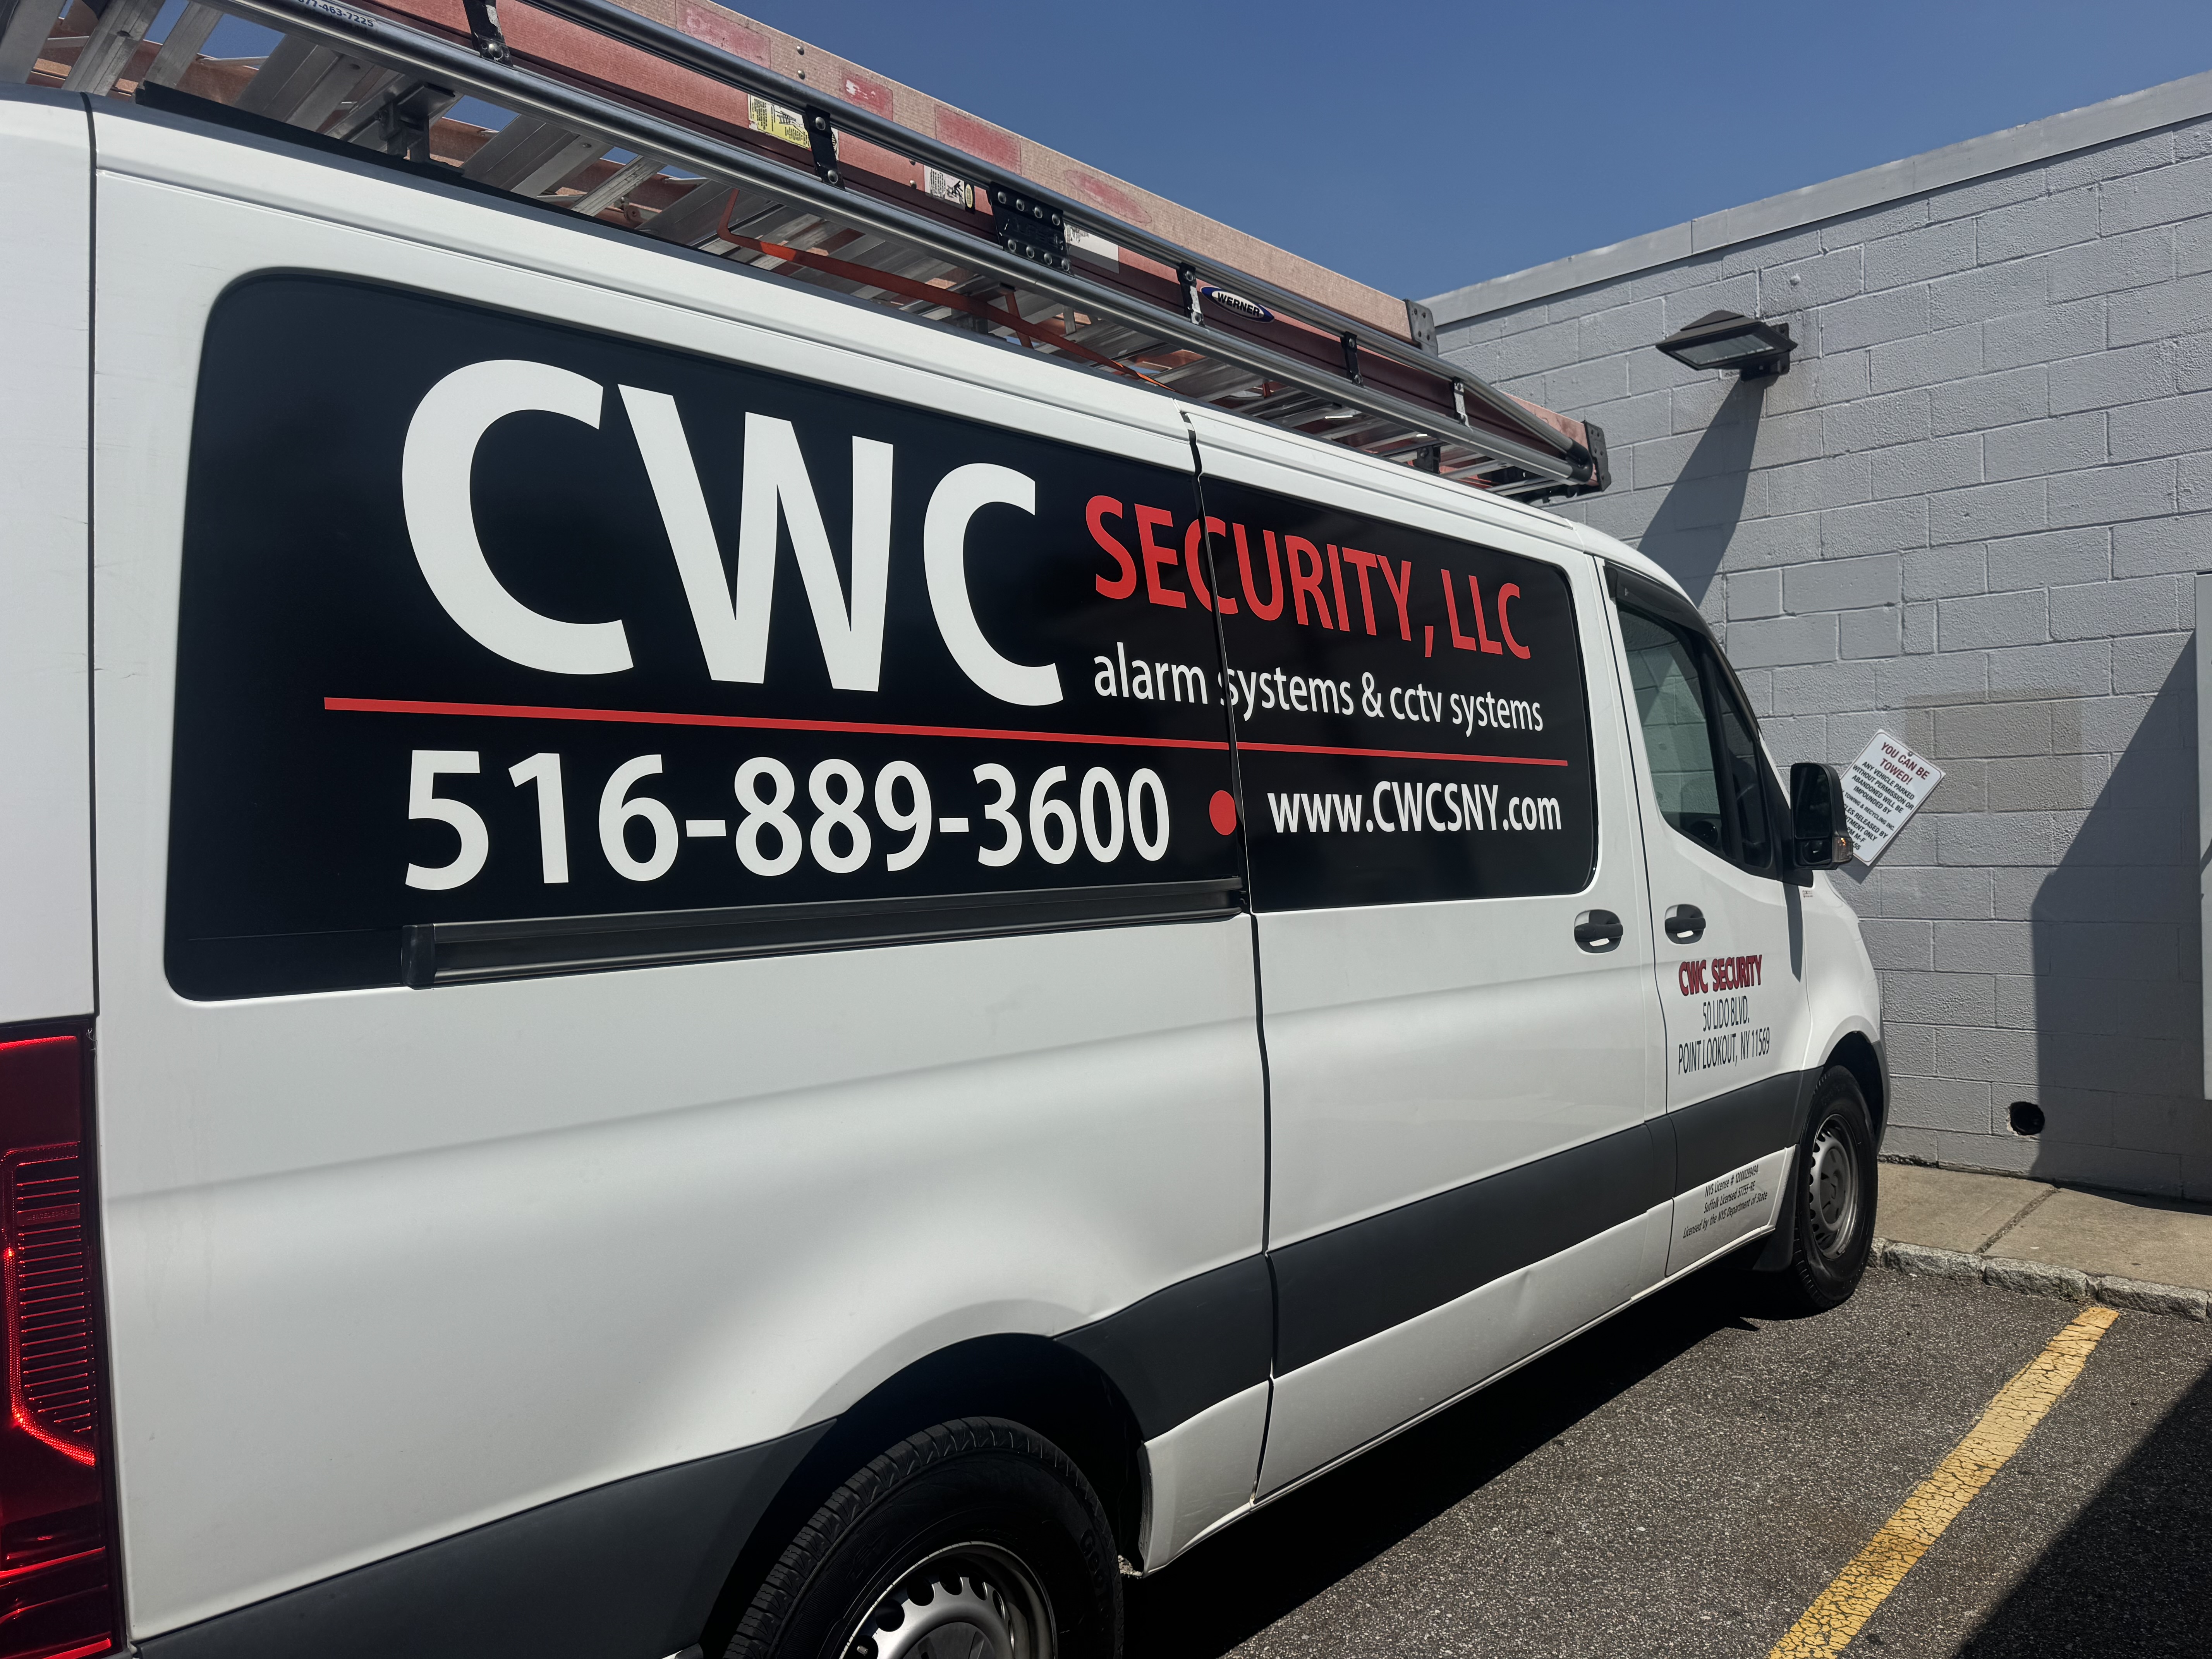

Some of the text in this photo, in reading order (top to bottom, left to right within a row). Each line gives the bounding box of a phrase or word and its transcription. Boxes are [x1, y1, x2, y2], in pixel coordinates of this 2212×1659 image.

[1218, 292, 1260, 317] WERNER
[403, 359, 1063, 706] CWC
[1085, 495, 1531, 659] SECURITY, LLC
[1094, 642, 1544, 737] alarm systems & cctv systems
[1880, 759, 1913, 785] TOWED!
[1881, 742, 1930, 780] YOU CAN BE
[1852, 775, 1884, 799] ABANDONED
[1882, 796, 1895, 809] WILL
[1895, 805, 1904, 813] BE
[1853, 765, 1914, 810] WITHOUT PERMISSION OR
[1853, 786, 1883, 810] IMPOUNDED
[1882, 806, 1892, 814] BY
[1862, 762, 1915, 800] ANY VEHICLE PARKED
[405, 750, 1170, 891] 516-889-3600
[1267, 781, 1562, 833] www.CWCSNY.com
[1844, 792, 1861, 806] TOWING
[1864, 806, 1887, 826] RECYCLING
[1886, 822, 1894, 831] INC.
[1854, 812, 1880, 833] RELEASED
[1854, 833, 1866, 842] M-F
[1864, 829, 1878, 842] ONLY
[1678, 955, 1762, 996] CWC SECURITY
[1703, 996, 1750, 1032] 50 LIDO BLVD.
[1678, 1027, 1770, 1075] POINT LOOKOUT, NY 11569
[1705, 1183, 1713, 1197] NYS
[1715, 1179, 1729, 1192] License
[1730, 1175, 1734, 1185] #
[1720, 1187, 1739, 1206] Licensed
[1683, 1218, 1702, 1238] Licensed
[1702, 1216, 1709, 1230] by
[1717, 1209, 1726, 1222] NYS
[1726, 1198, 1750, 1218] Department
[1751, 1197, 1757, 1205] of
[1757, 1192, 1767, 1203] State
